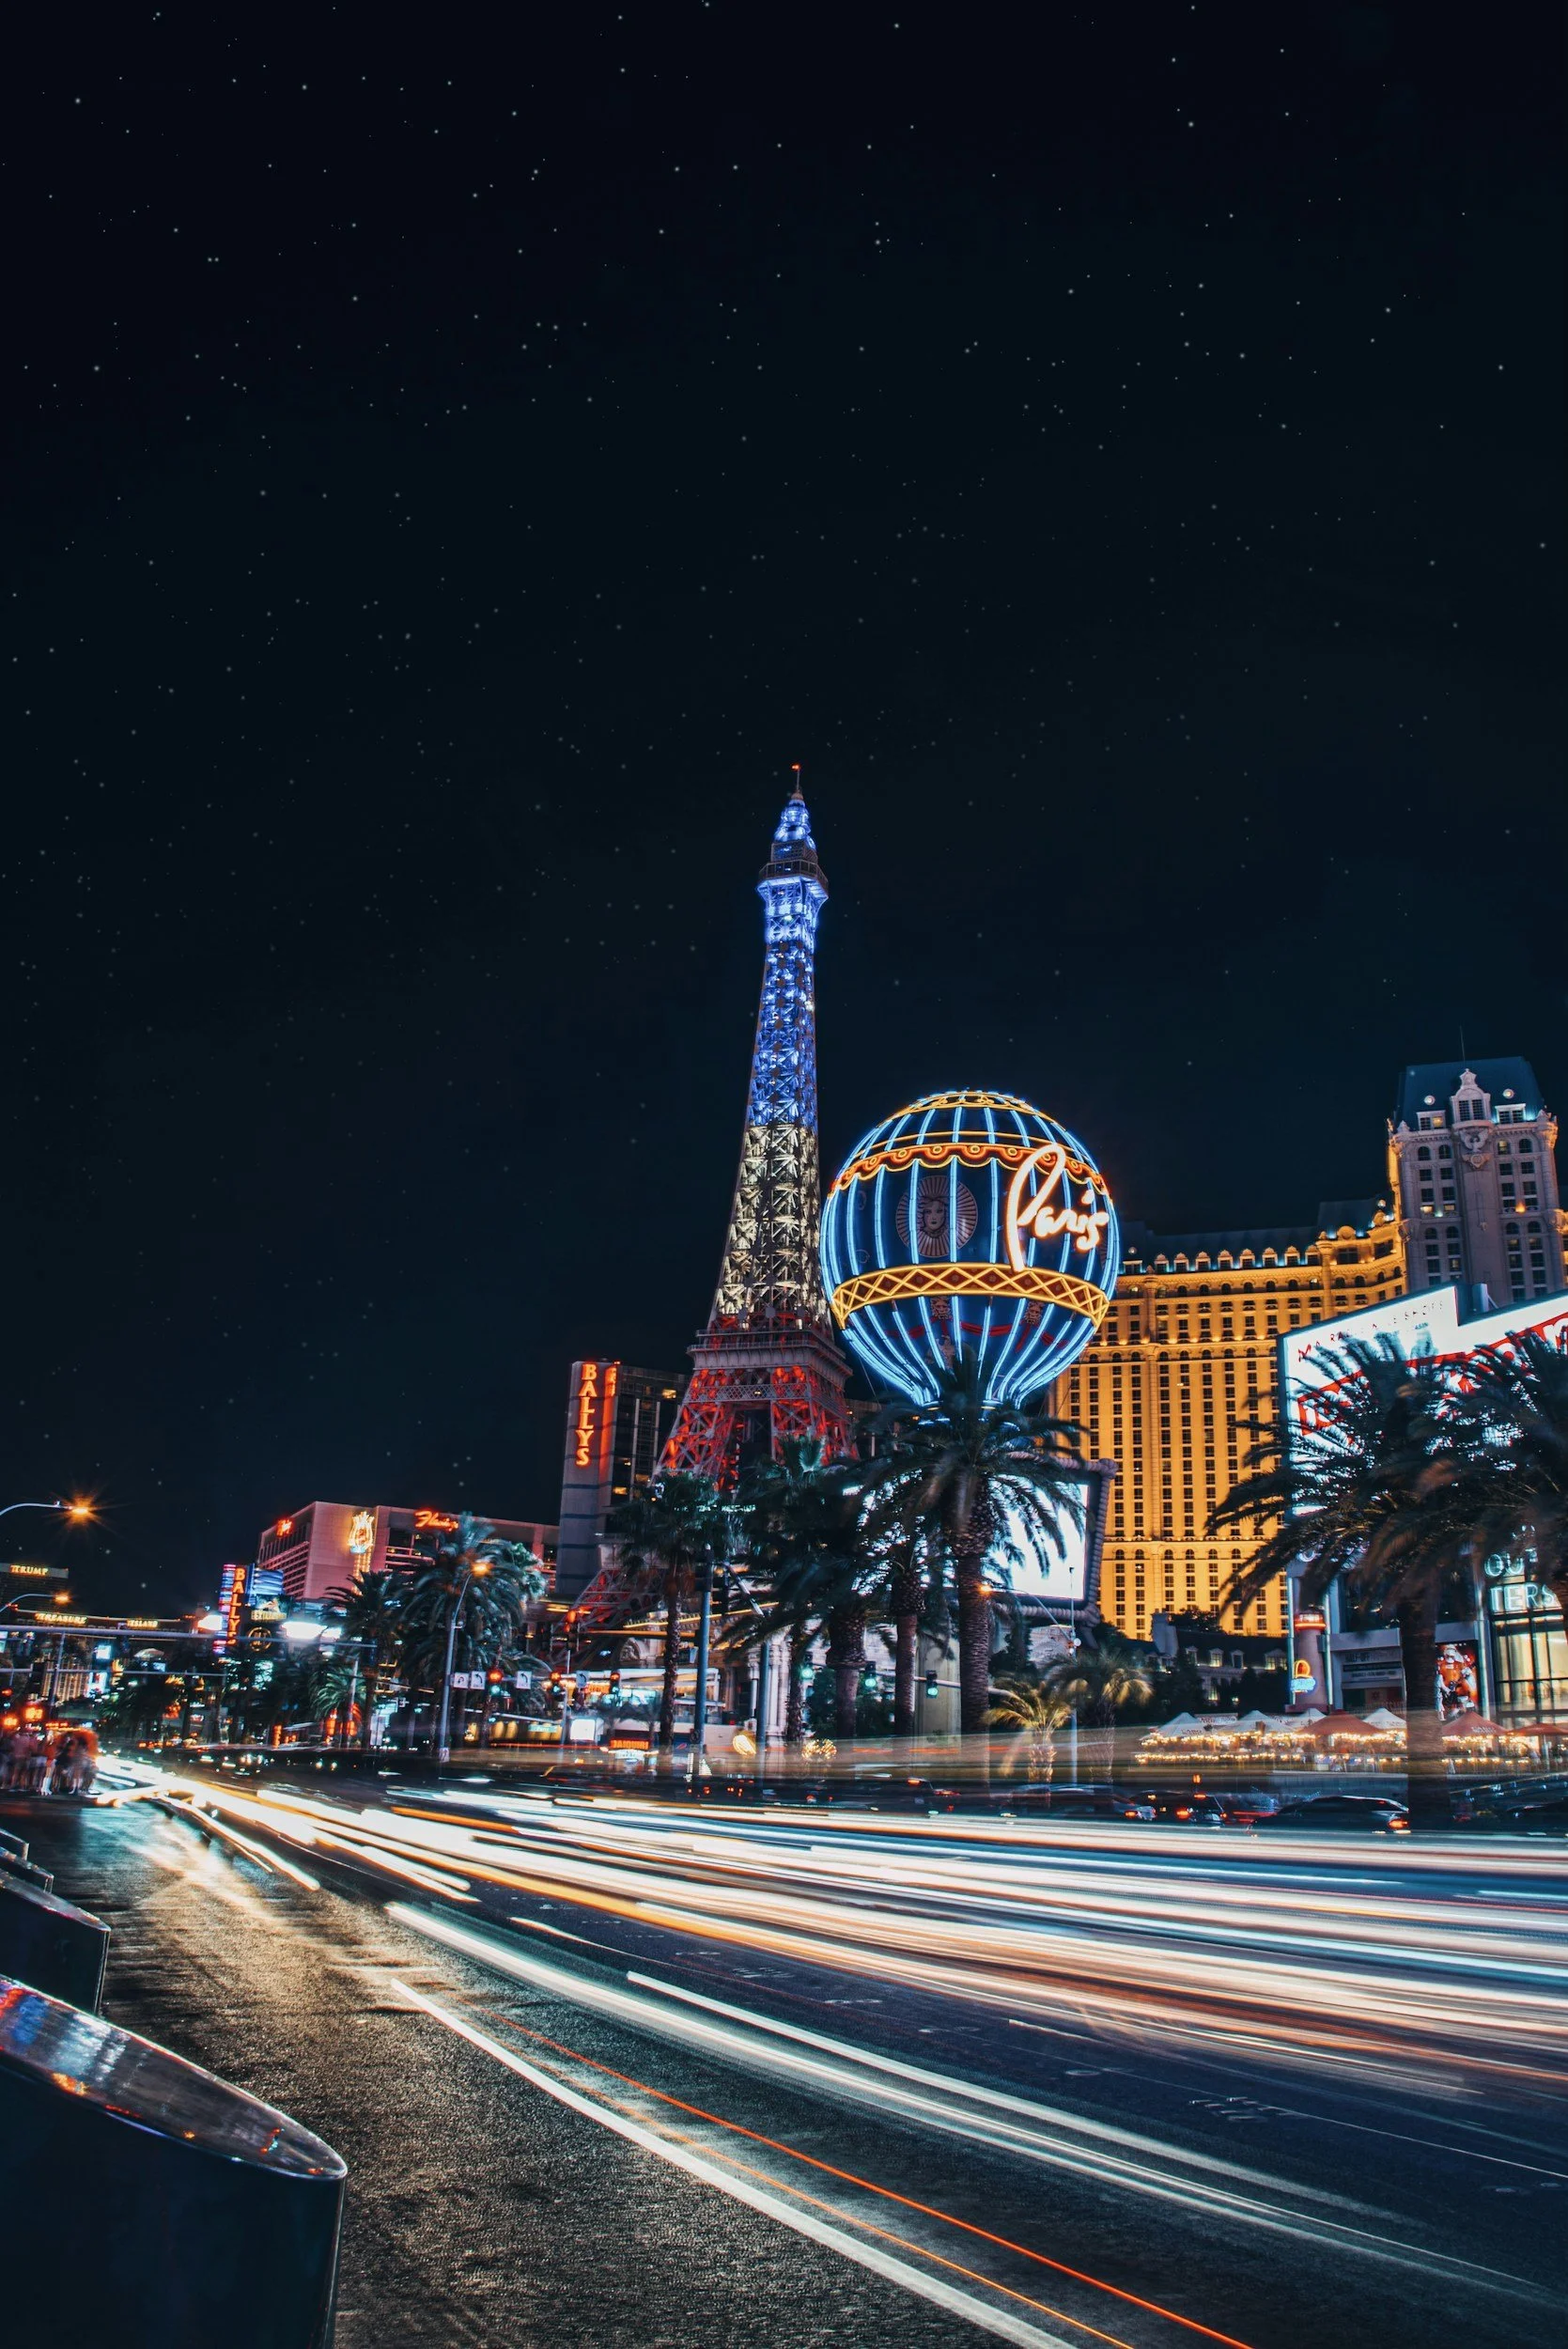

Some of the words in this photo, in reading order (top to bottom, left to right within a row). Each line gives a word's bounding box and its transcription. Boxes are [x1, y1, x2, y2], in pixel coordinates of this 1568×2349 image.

[1006, 1143, 1110, 1272] Paris
[576, 1363, 598, 1466] BALLYS
[9, 1564, 48, 1576] TRUMP
[35, 1612, 87, 1625] TREASURE
[126, 1619, 159, 1628] ISLAND
